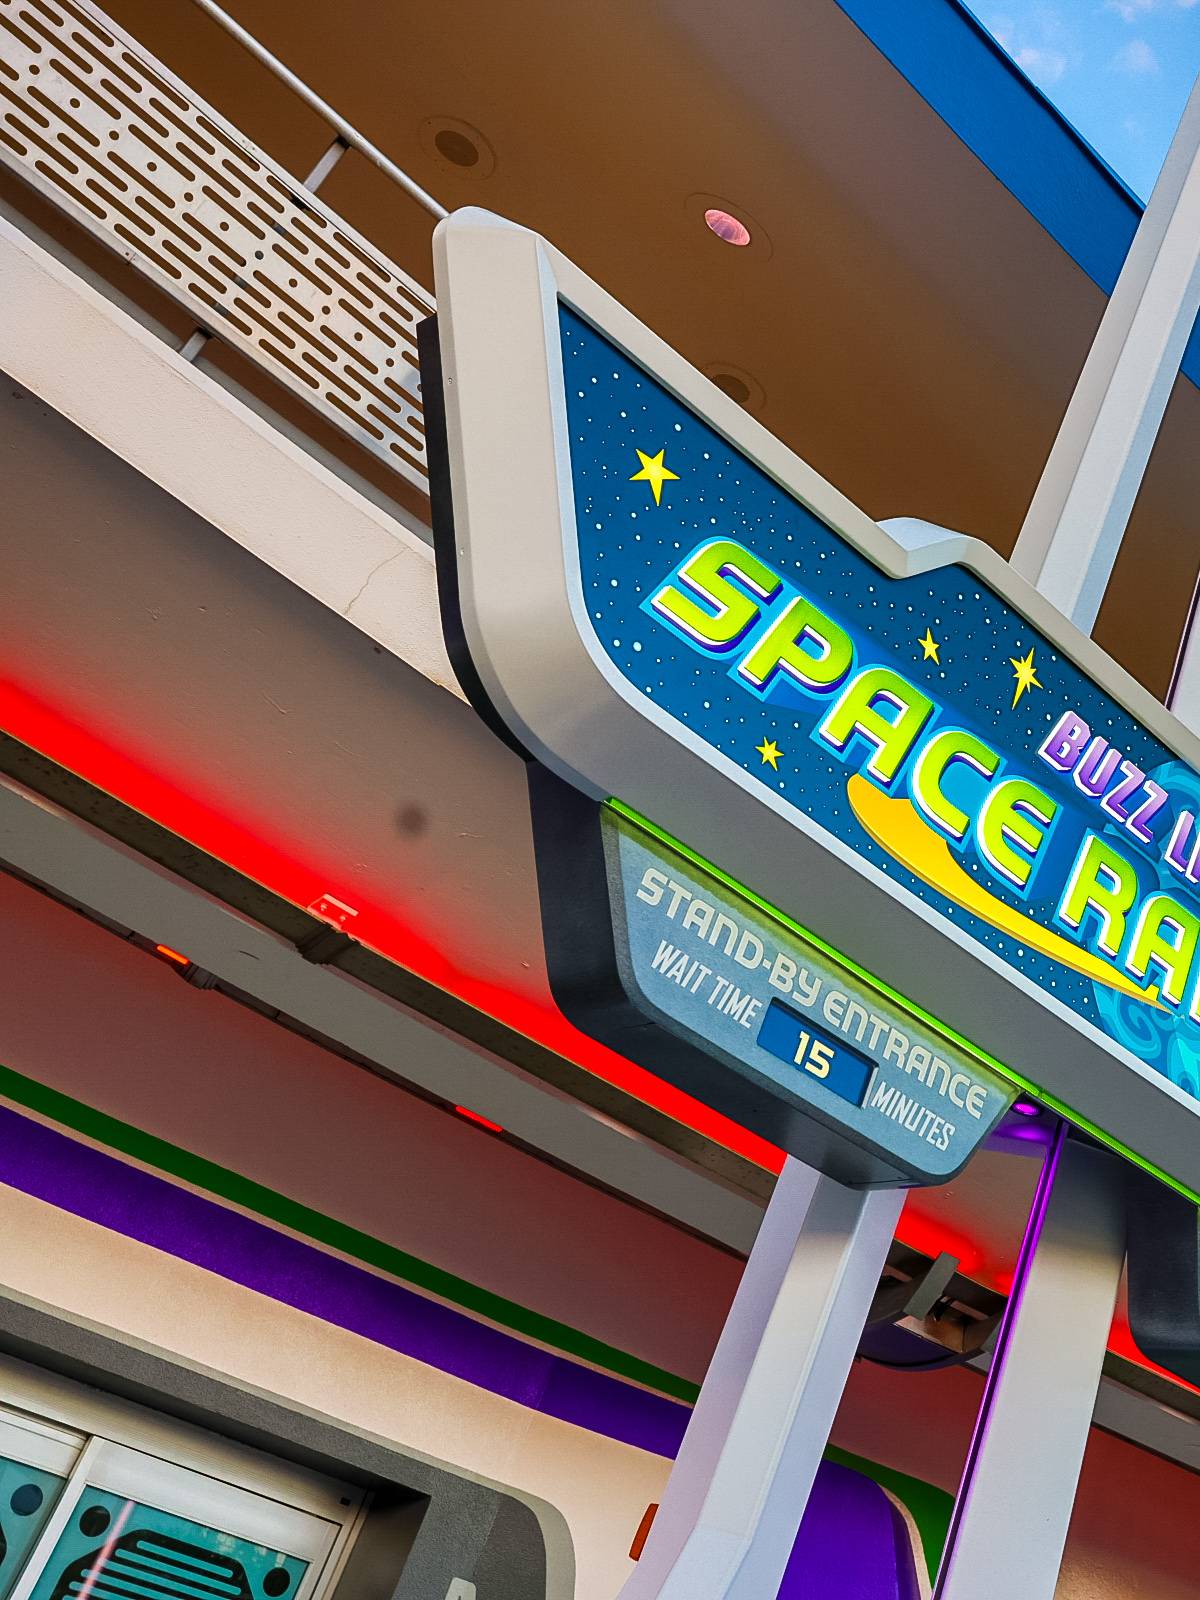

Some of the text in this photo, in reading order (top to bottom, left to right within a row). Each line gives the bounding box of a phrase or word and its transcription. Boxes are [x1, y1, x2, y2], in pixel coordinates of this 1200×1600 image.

[648, 538, 1058, 888] SPACE
[1038, 711, 1168, 843] BUZZ
[636, 868, 988, 1119] STAND-BY ENTRANCE
[651, 940, 762, 1029] WAIT TIME
[793, 1030, 835, 1080] 15
[872, 1080, 956, 1153] MINUTES
